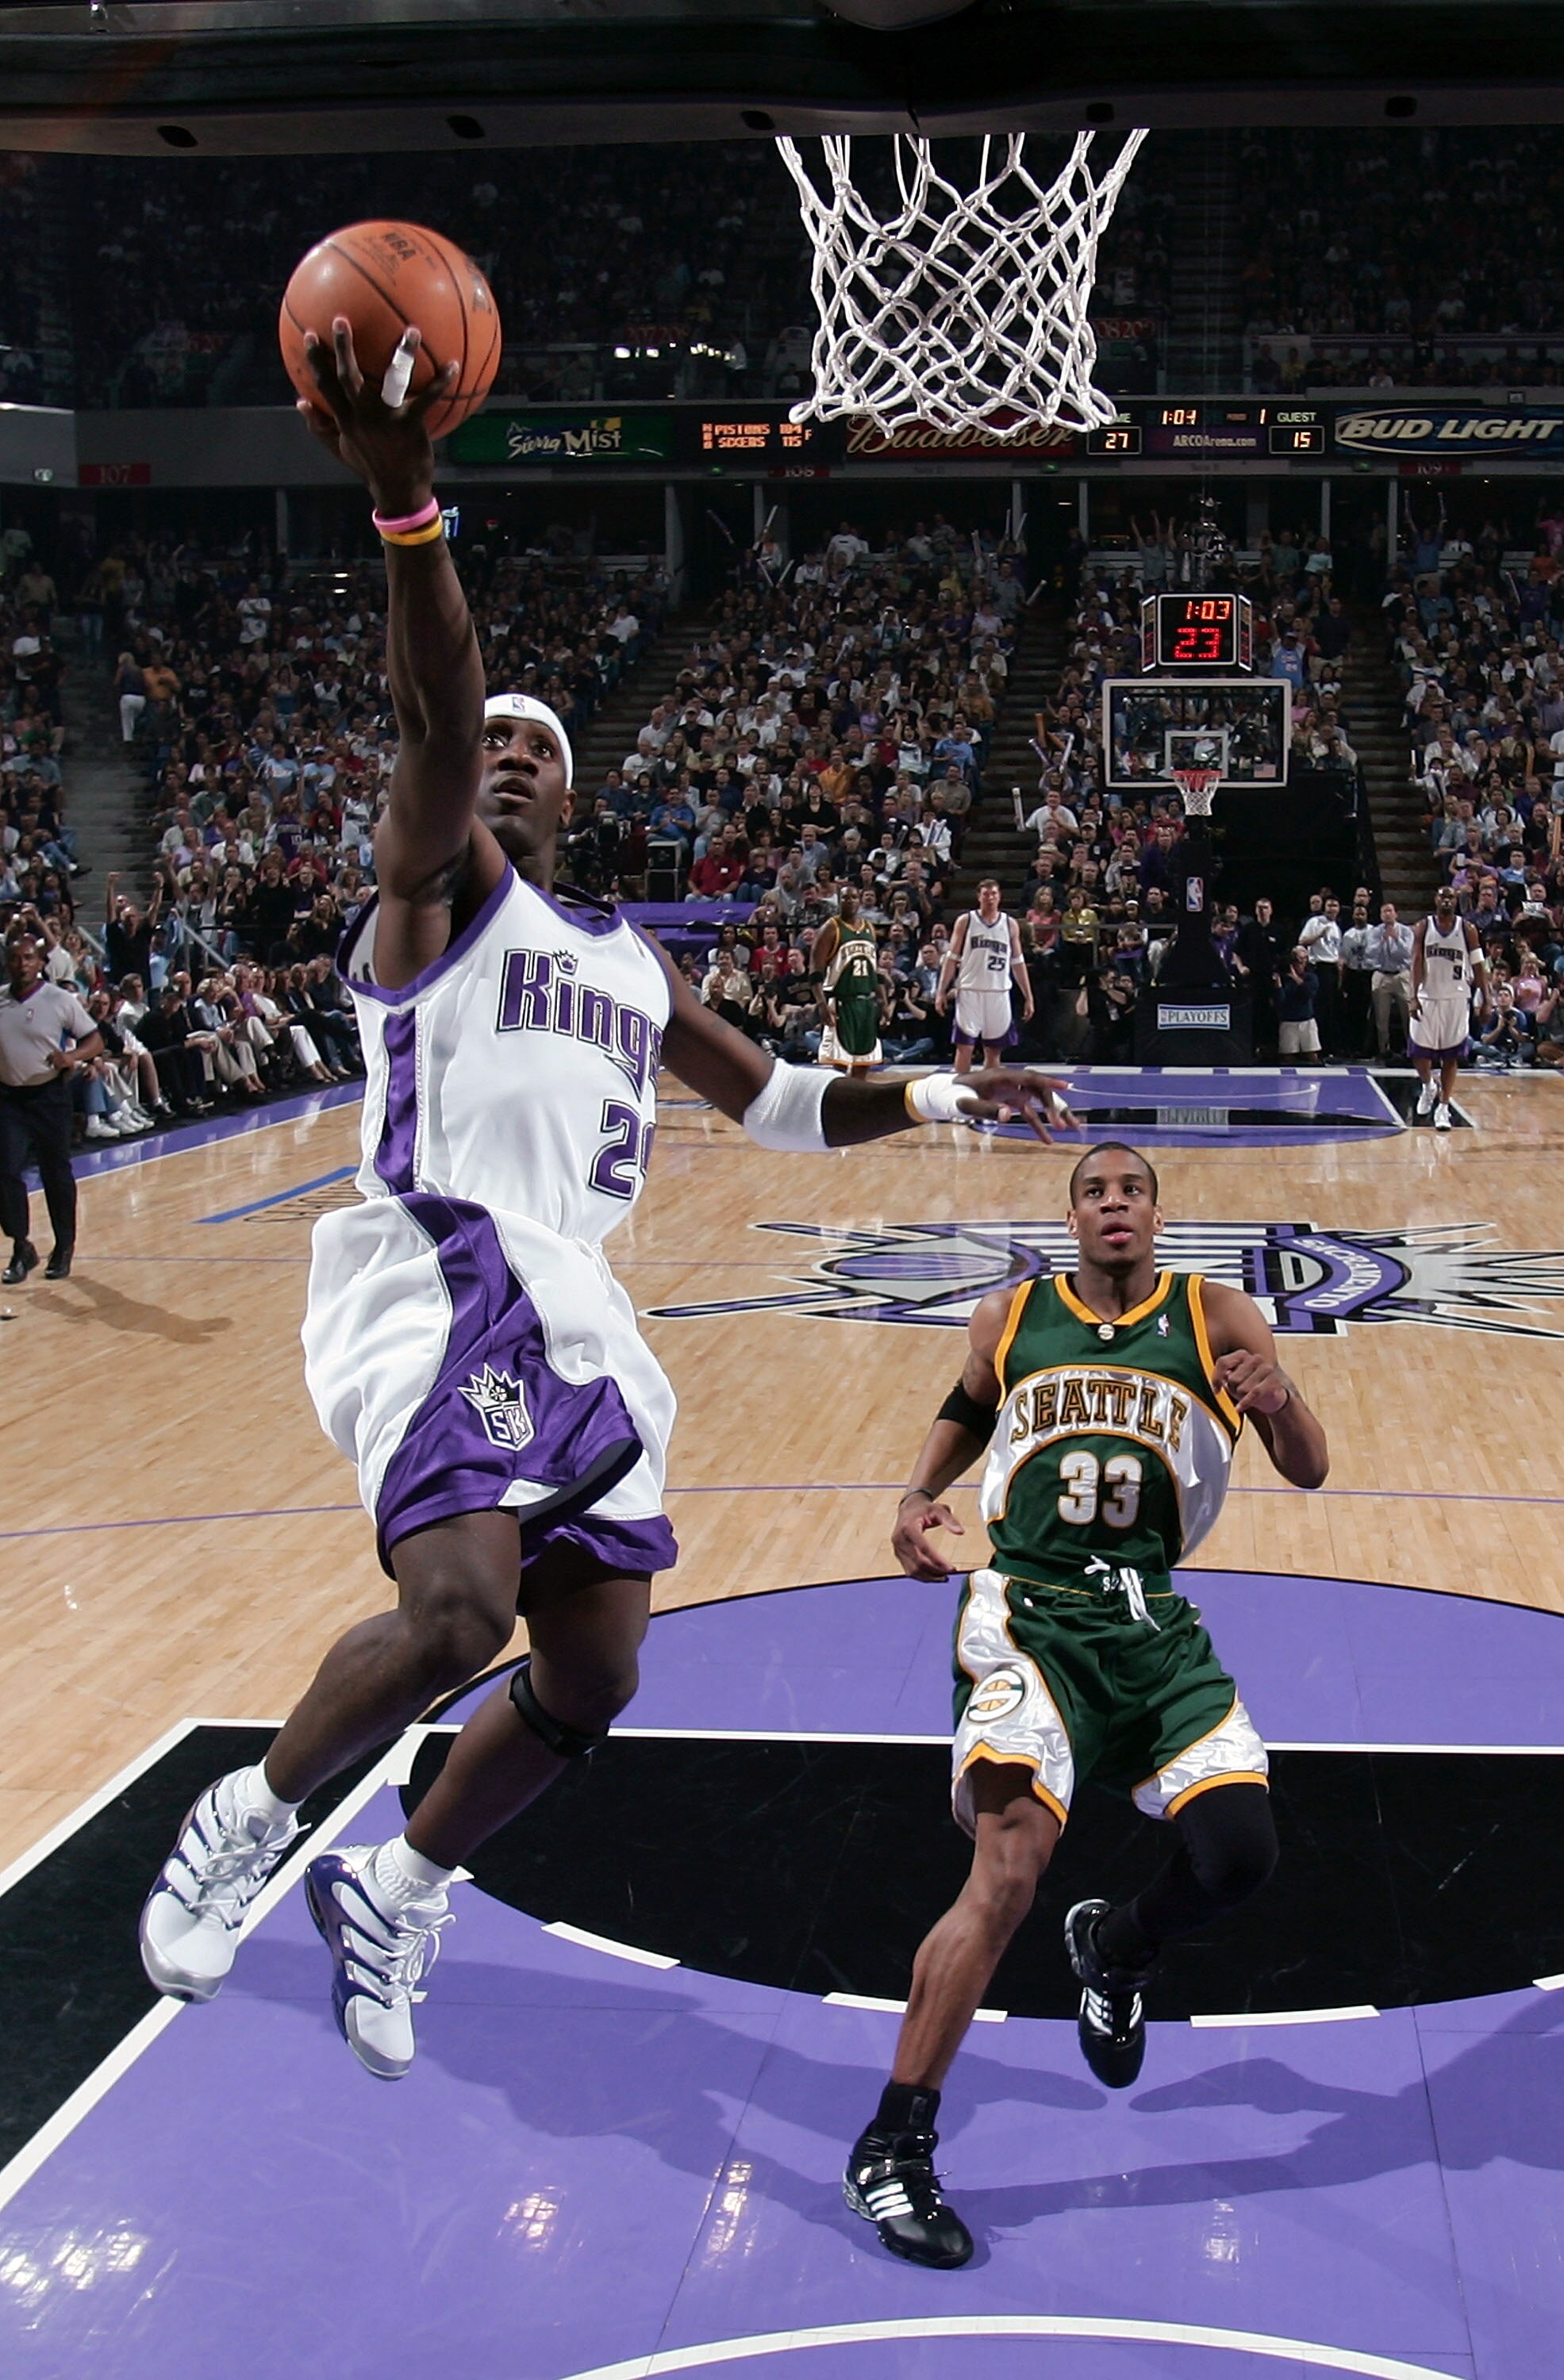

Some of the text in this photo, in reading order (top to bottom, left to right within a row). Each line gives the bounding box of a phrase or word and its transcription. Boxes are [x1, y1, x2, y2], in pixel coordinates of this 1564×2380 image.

[1162, 409, 1196, 425] 1:04
[1259, 409, 1266, 424] 1
[1277, 412, 1316, 422] GUEST
[714, 424, 770, 435] PISTONS
[805, 429, 813, 440] F
[1341, 419, 1564, 440] BUD LIGHT
[561, 428, 621, 454] Mist
[718, 436, 766, 447] SIXERS
[1105, 432, 1128, 449] 27
[1293, 432, 1311, 447] 15
[1186, 601, 1230, 619] 1:03
[1174, 628, 1219, 658] 23
[853, 959, 869, 977] 21
[988, 956, 1005, 971] 25
[1453, 965, 1462, 980] 9
[1167, 1009, 1228, 1023] PLAYOFFS
[1293, 1238, 1382, 1308] SACRAMENTO
[1009, 1379, 1188, 1453] SEATTLE
[1057, 1449, 1143, 1530] 33
